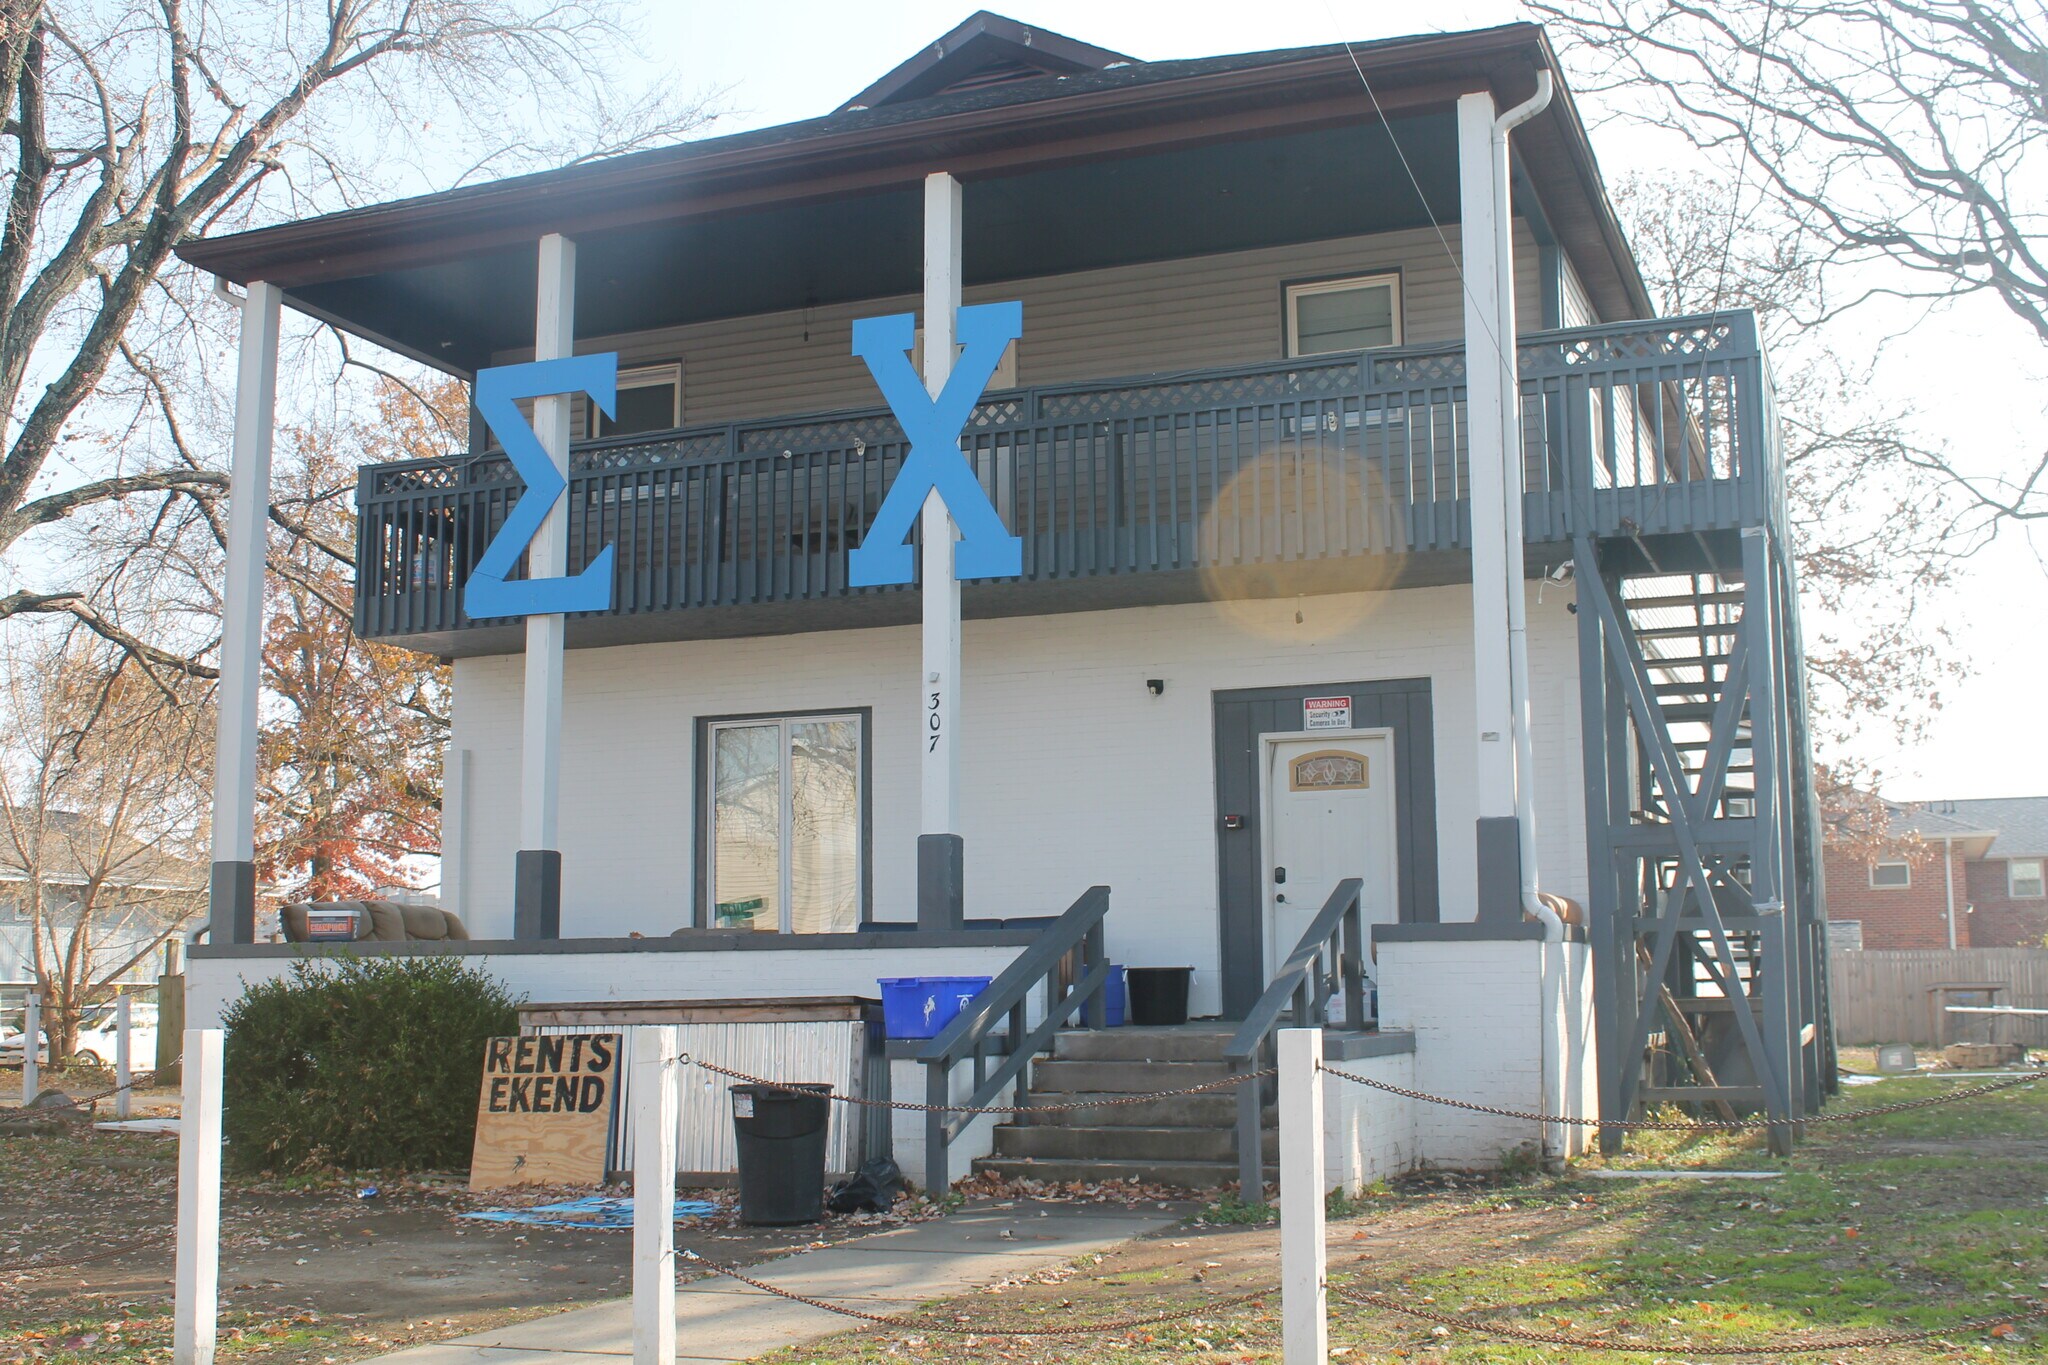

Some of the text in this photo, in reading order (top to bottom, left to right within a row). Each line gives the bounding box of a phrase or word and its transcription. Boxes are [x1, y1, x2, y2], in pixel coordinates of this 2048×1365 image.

[1308, 699, 1347, 709] WARNING
[1310, 711, 1330, 719] Security
[928, 692, 941, 754] 307
[1310, 719, 1330, 727] Cameras
[1337, 718, 1346, 726] Use
[487, 1035, 614, 1074] RENTS
[489, 1075, 605, 1113] EKEND
